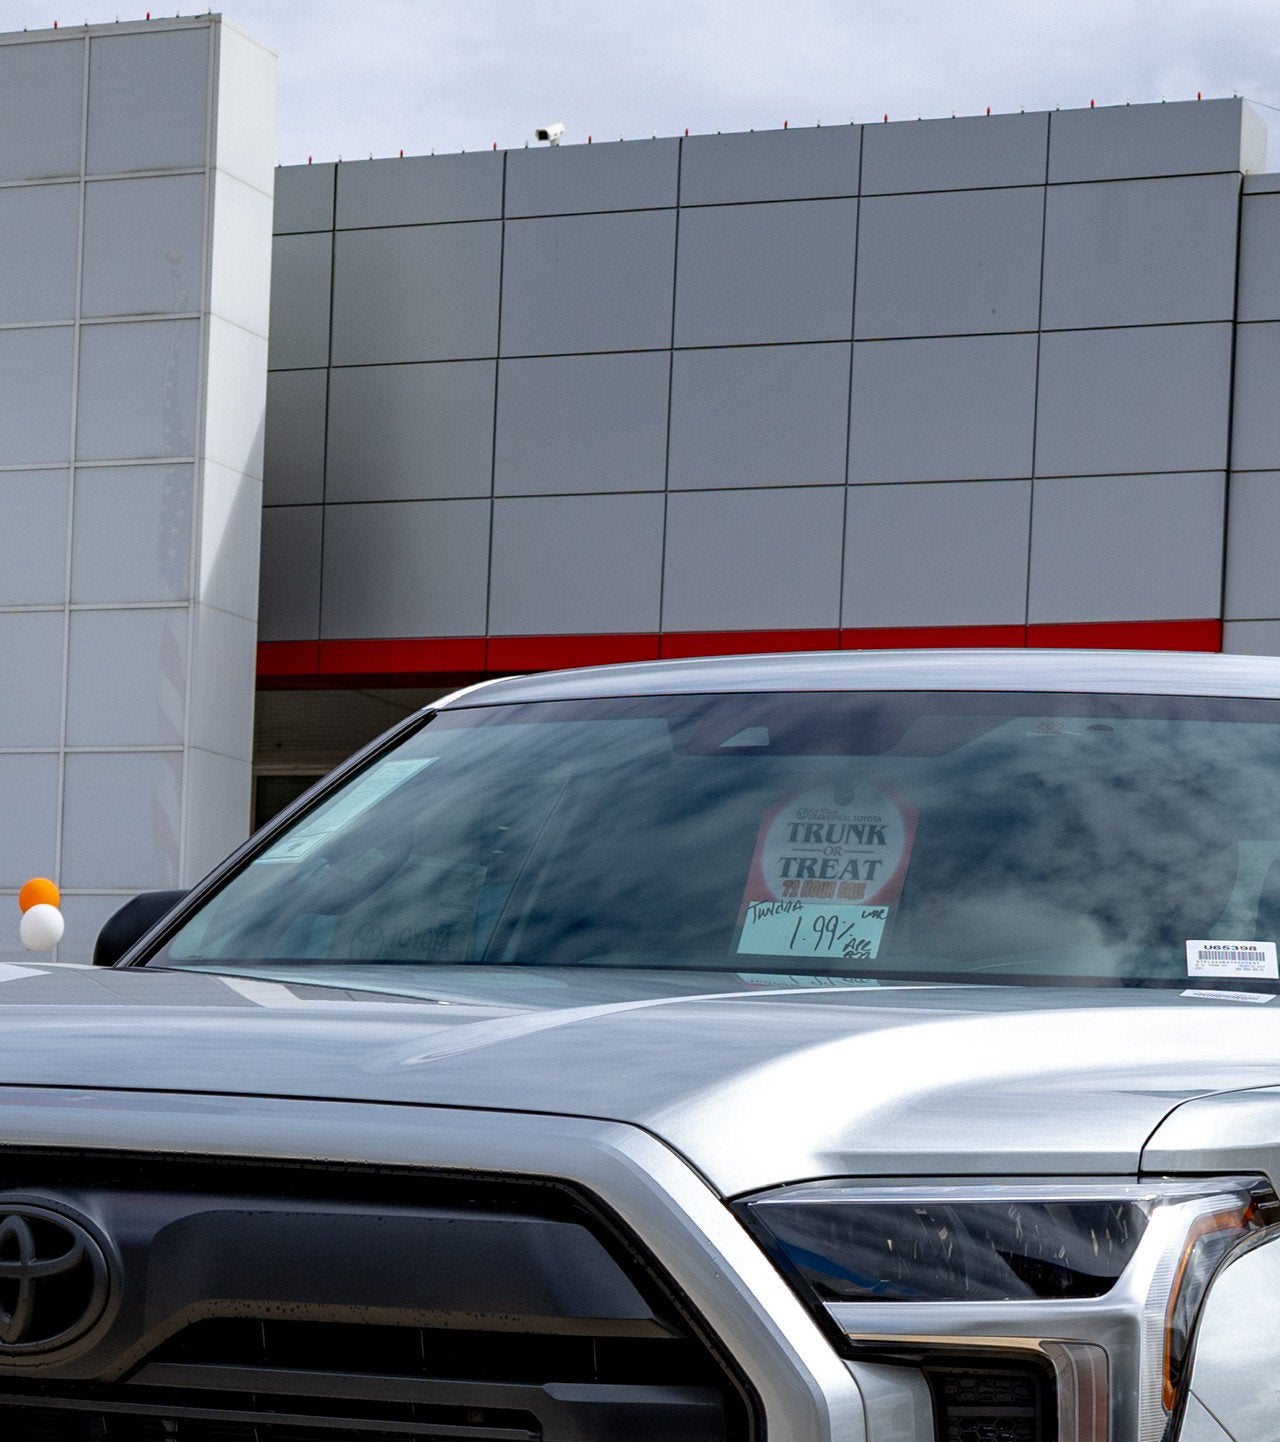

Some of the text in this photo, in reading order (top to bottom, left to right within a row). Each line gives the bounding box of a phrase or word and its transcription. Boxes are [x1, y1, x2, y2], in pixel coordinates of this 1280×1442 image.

[808, 813, 882, 823] UNIVERSAL TOYOTA
[786, 822, 890, 846] TRUNK
[823, 846, 843, 857] OR
[778, 857, 883, 880] TREAT
[782, 879, 800, 898] 72
